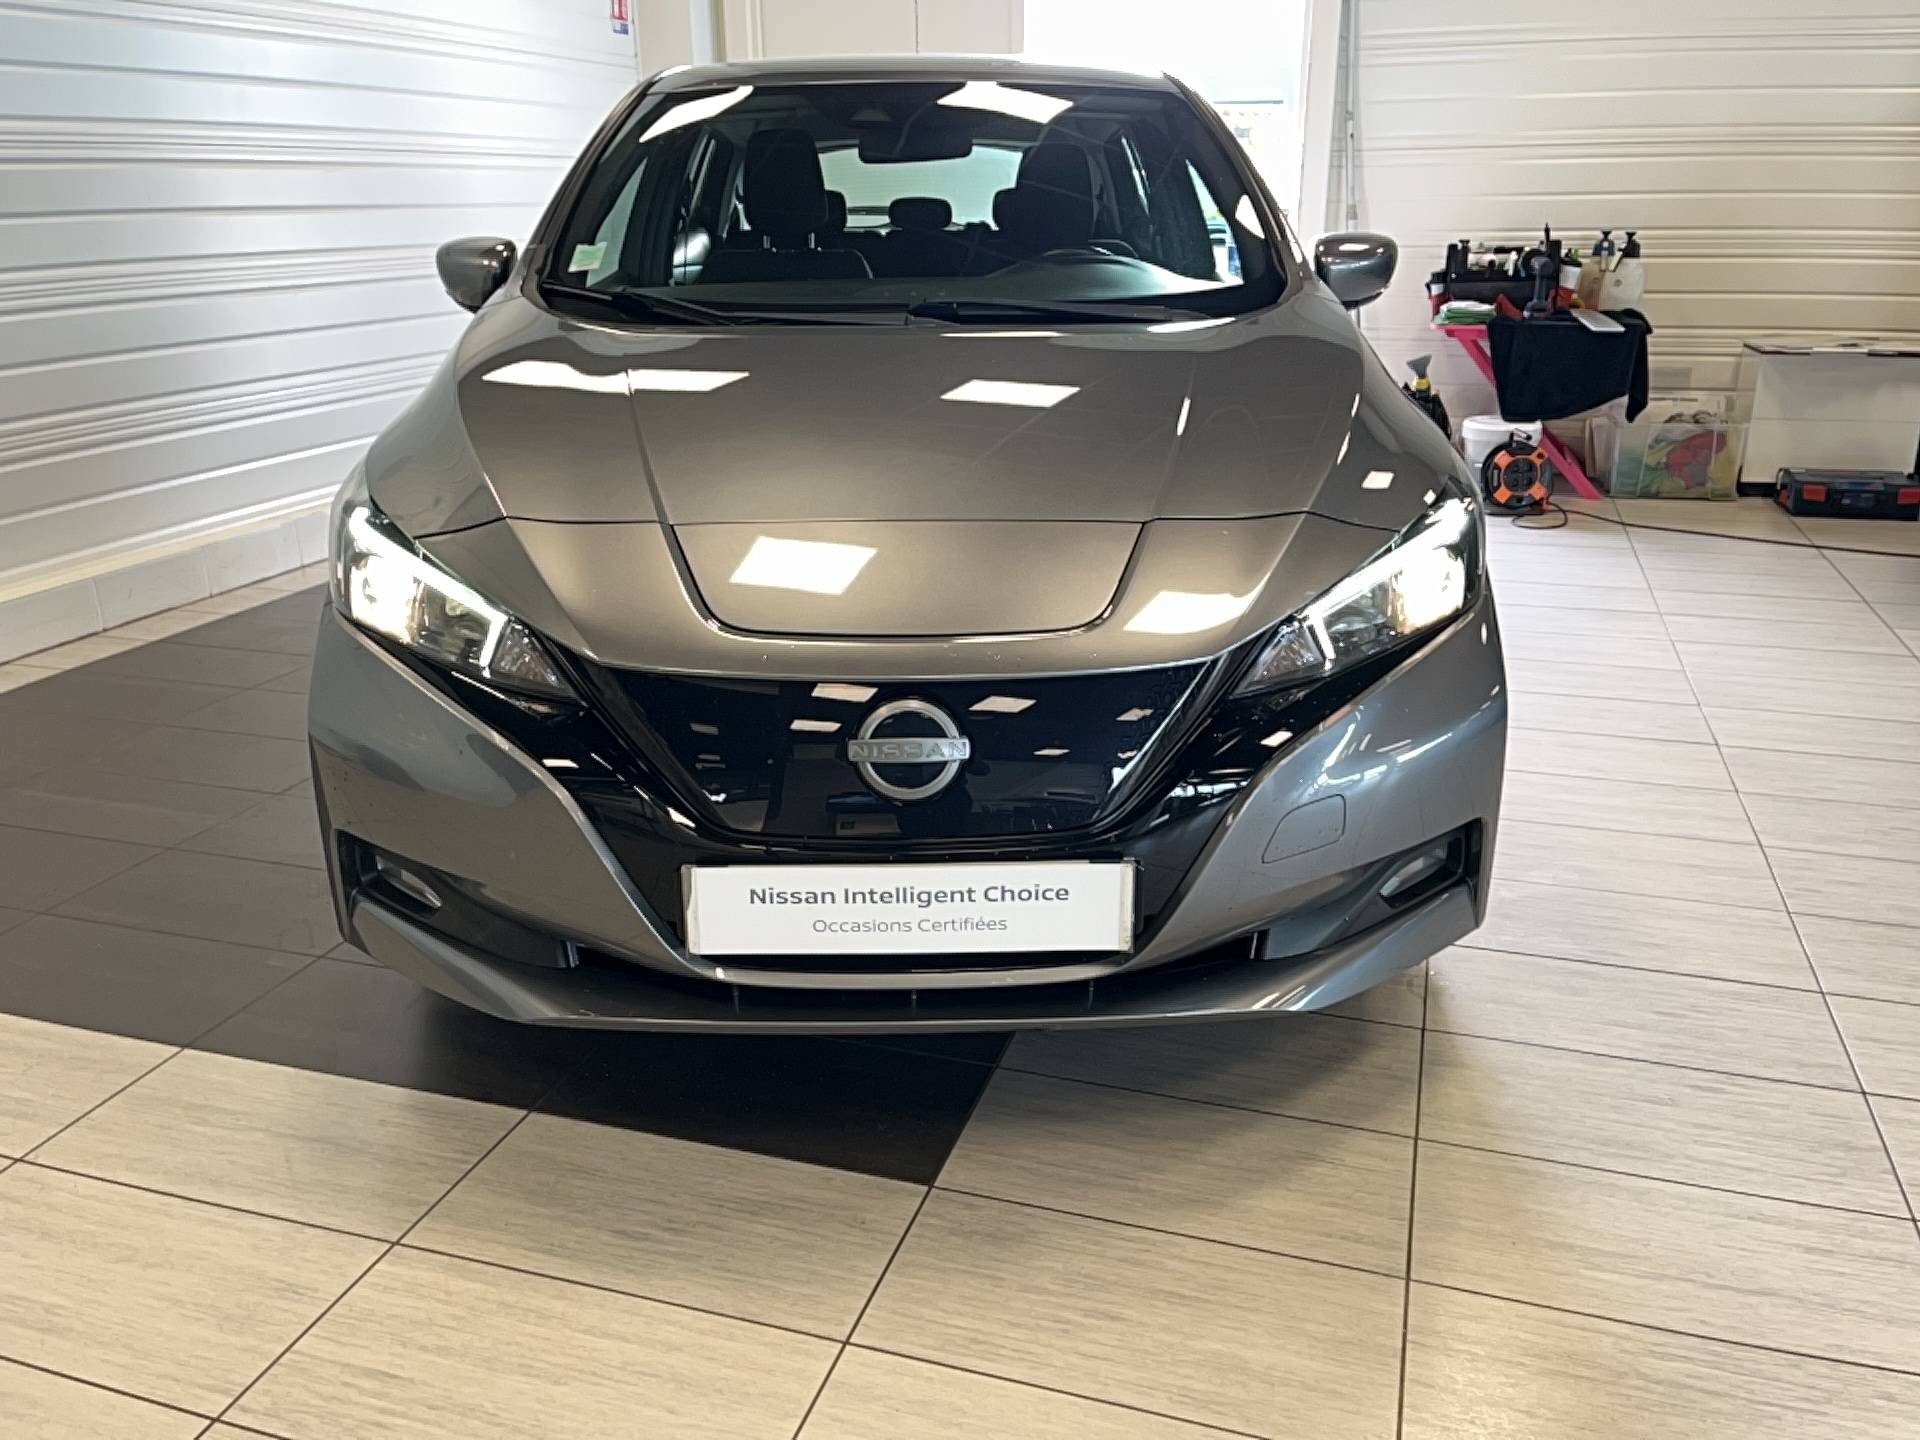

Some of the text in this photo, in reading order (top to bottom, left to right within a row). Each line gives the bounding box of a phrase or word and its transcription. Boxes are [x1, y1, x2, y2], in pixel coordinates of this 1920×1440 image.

[851, 742, 967, 759] NISSAN
[749, 883, 1070, 909] Nissan Intelligent Choice
[812, 916, 1008, 933] Occasions Certifiées
